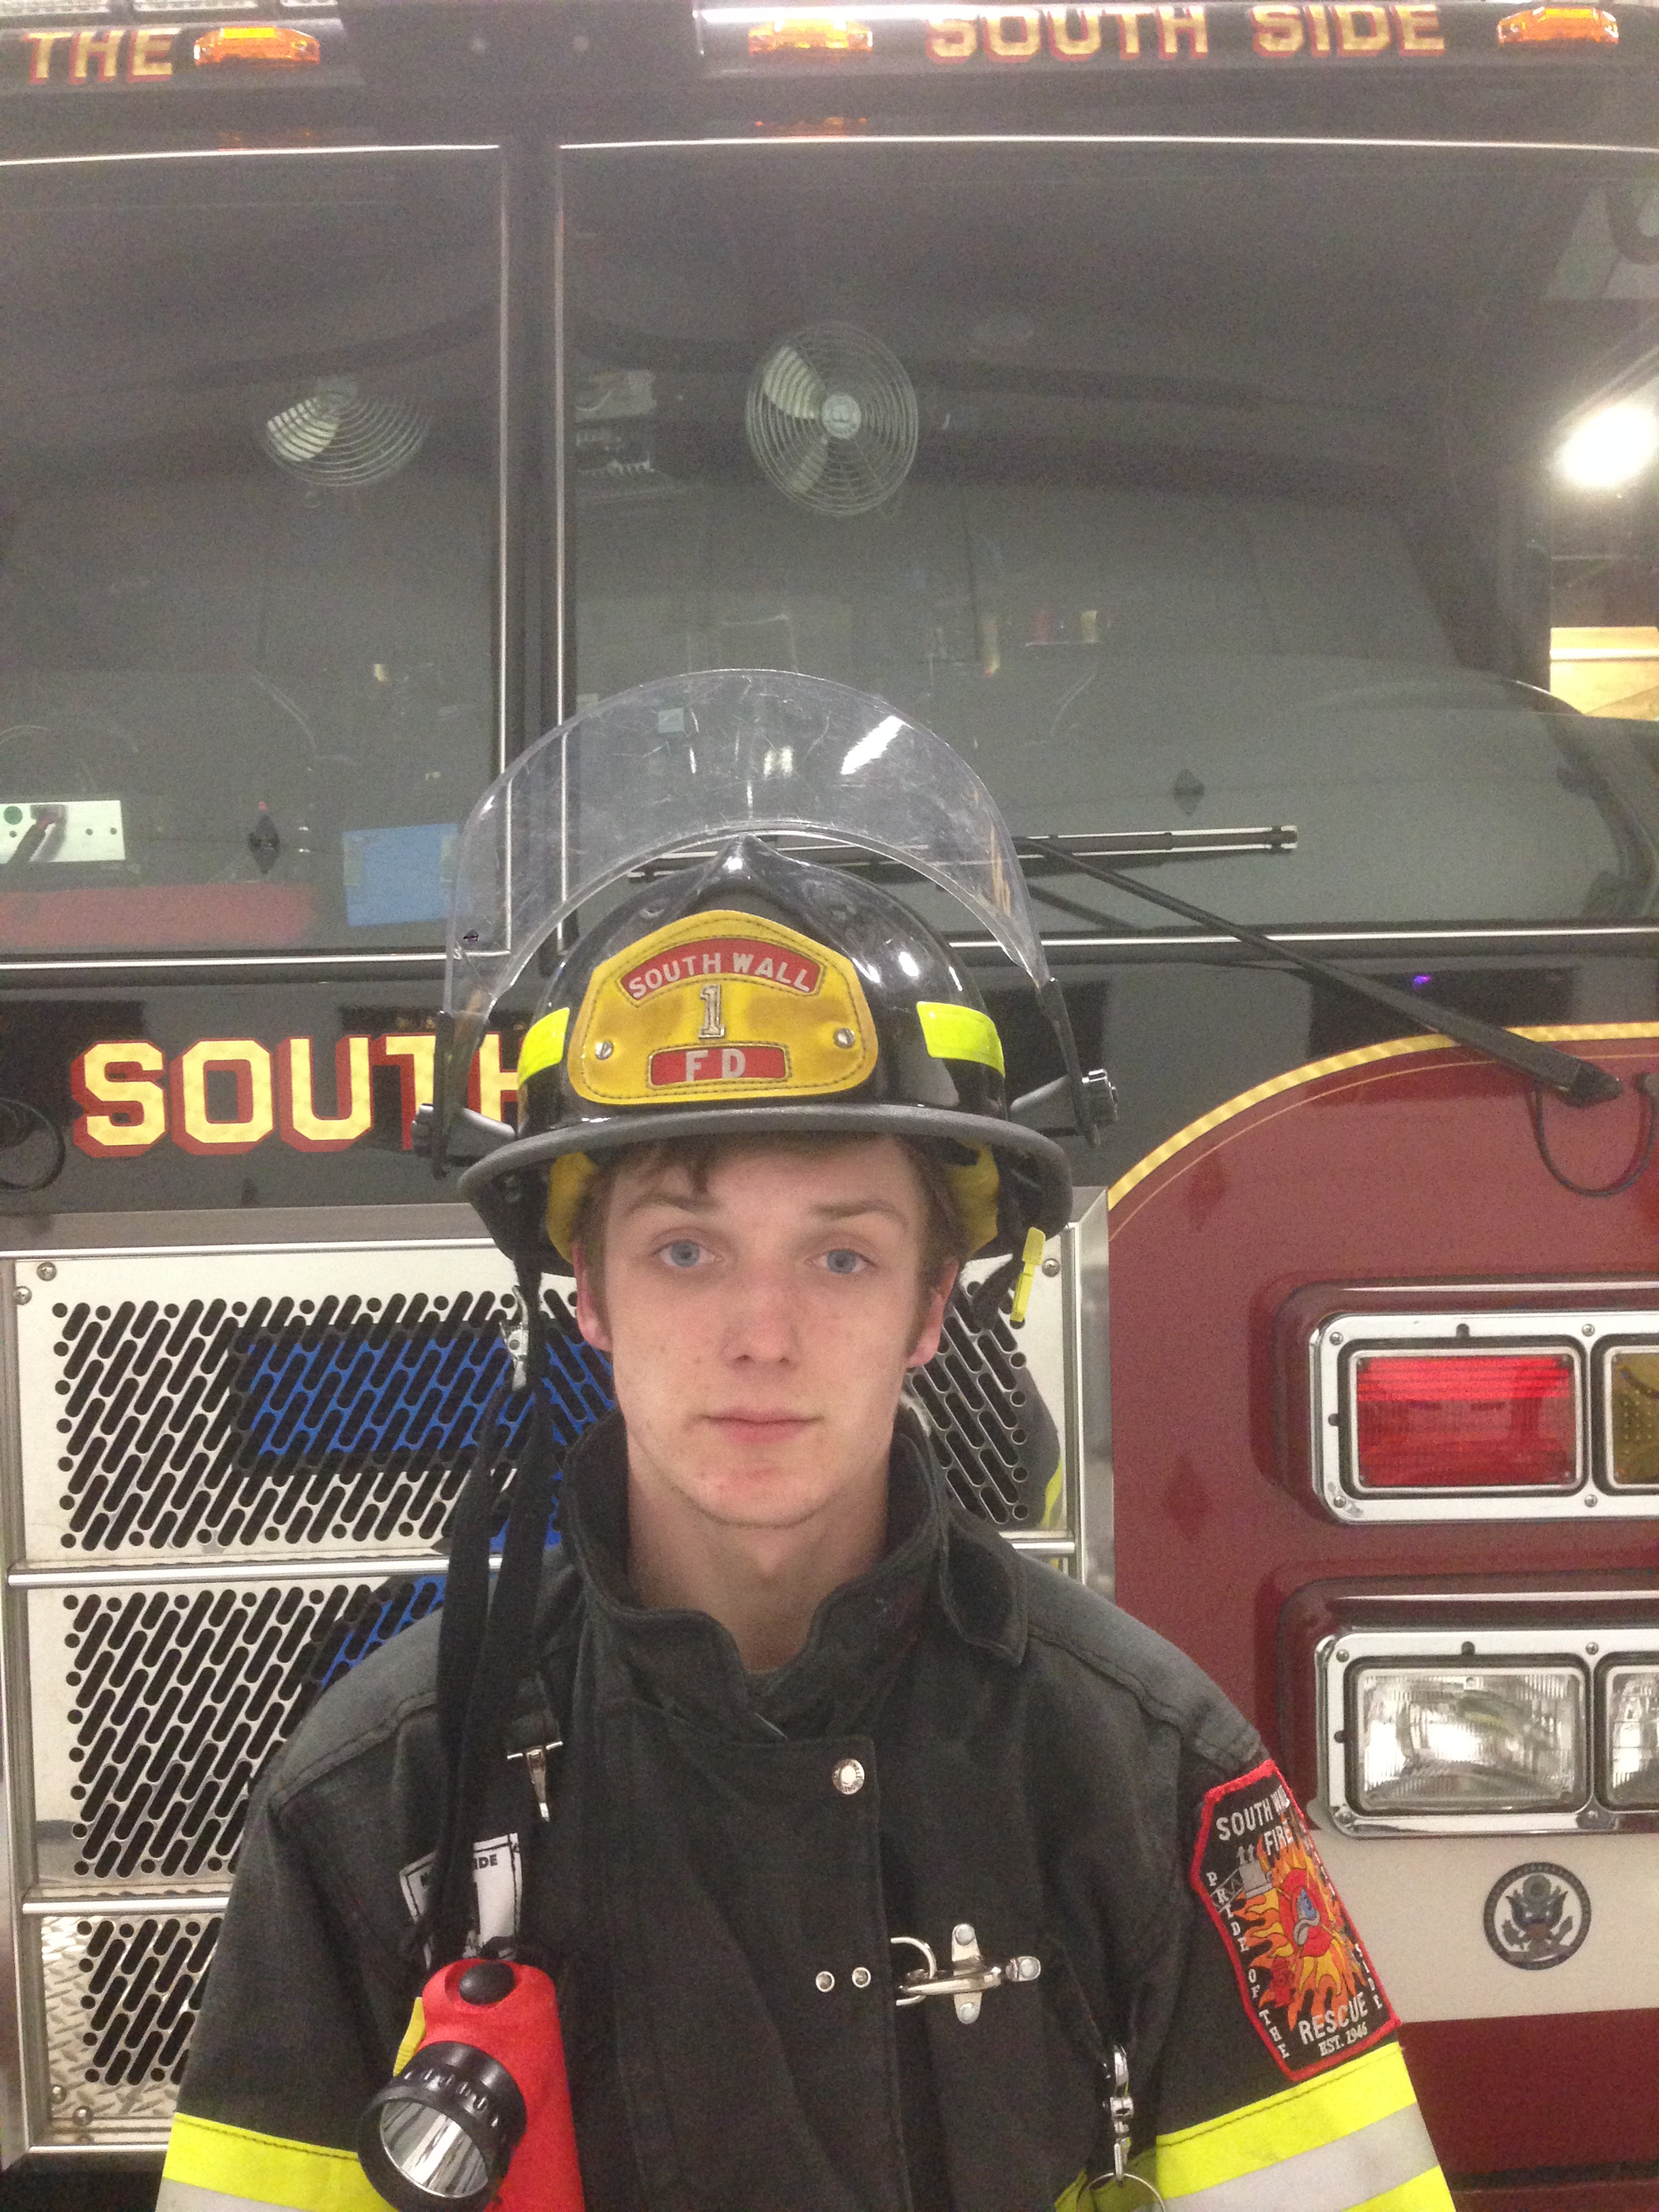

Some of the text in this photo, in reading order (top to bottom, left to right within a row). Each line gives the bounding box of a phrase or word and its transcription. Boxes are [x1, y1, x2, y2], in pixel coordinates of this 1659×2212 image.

[22, 5, 1446, 85] THE SOUTH SIDE
[628, 952, 811, 1000] SOUTH WALL
[699, 984, 725, 1039] 1
[1216, 1797, 1274, 1841] SOUTH
[1263, 1818, 1294, 1856] FIRE
[1248, 1968, 1261, 1999] OF
[1258, 2009, 1290, 2059] THE
[1298, 1991, 1368, 2045] RESCUE
[1318, 2034, 1345, 2056] EST.
